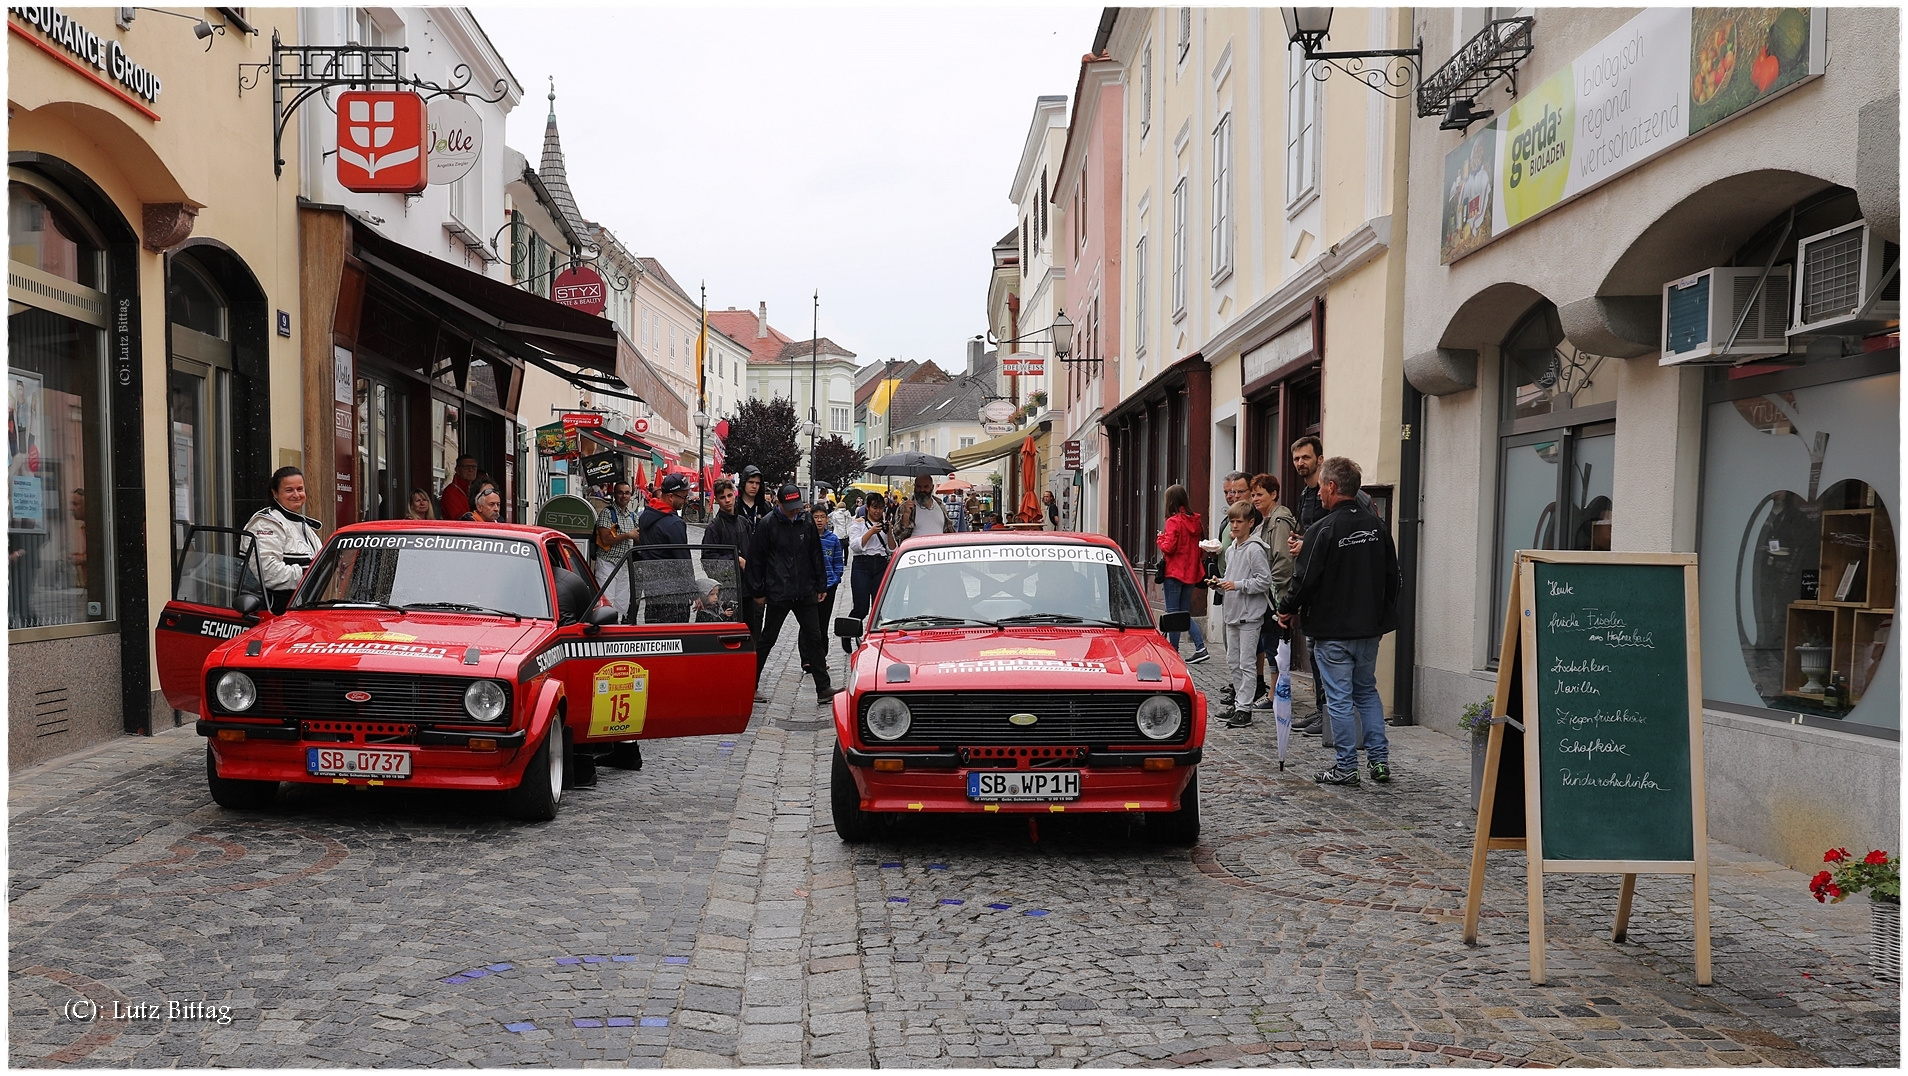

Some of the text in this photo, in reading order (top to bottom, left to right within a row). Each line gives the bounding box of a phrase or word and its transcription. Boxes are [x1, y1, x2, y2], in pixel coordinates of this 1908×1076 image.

[110, 40, 162, 103] GROUP
[1583, 29, 1645, 97] biologisch
[1581, 78, 1632, 139] regional
[1580, 93, 1679, 178] wertschätzend
[1529, 140, 1566, 177] BIOLADEN
[557, 285, 599, 299] STYX
[282, 315, 287, 327] 9
[336, 412, 352, 428] STYX
[546, 513, 587, 526] STYX
[337, 535, 530, 556] motoren-schumann.de
[908, 545, 1114, 566] schumann-motorsport.de
[292, 642, 447, 655] SCHUMANN
[605, 641, 681, 654] MOTORENTECHNIK
[610, 694, 630, 723] 15
[321, 752, 405, 772] SB 0737
[981, 775, 1077, 793] SB WP1H
